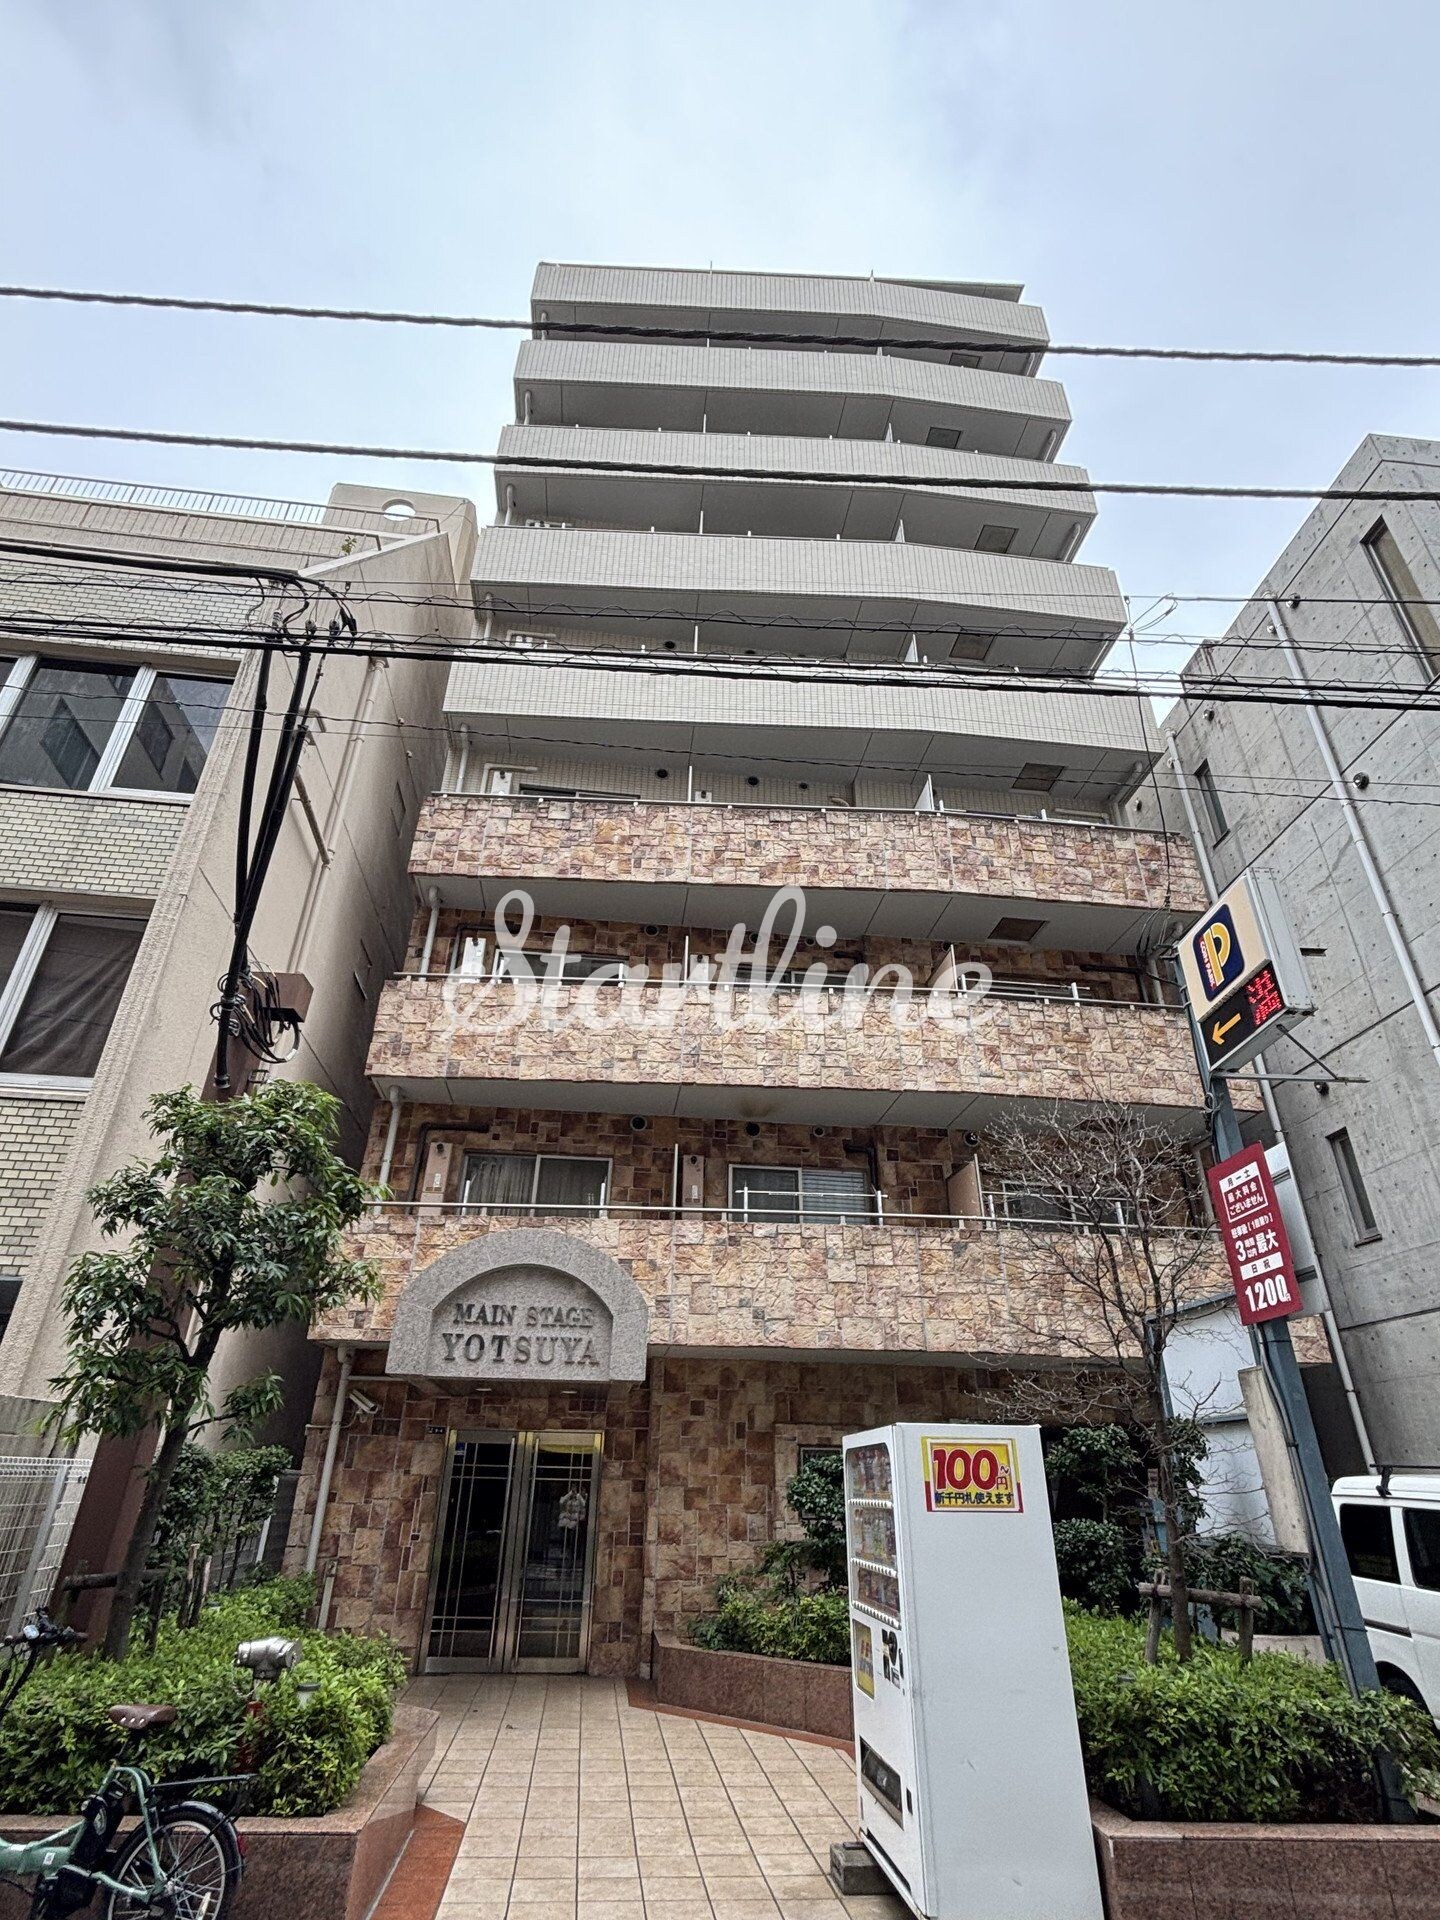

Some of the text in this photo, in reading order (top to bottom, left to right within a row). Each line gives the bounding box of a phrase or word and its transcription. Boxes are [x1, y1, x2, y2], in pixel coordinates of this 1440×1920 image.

[1227, 1181, 1258, 1203] 最大料金
[1229, 1193, 1264, 1216] ございません
[452, 1302, 594, 1329] MAIN STAGE
[442, 1332, 600, 1366] YOTSUYA
[934, 1491, 1014, 1505] 新千円札使えます
